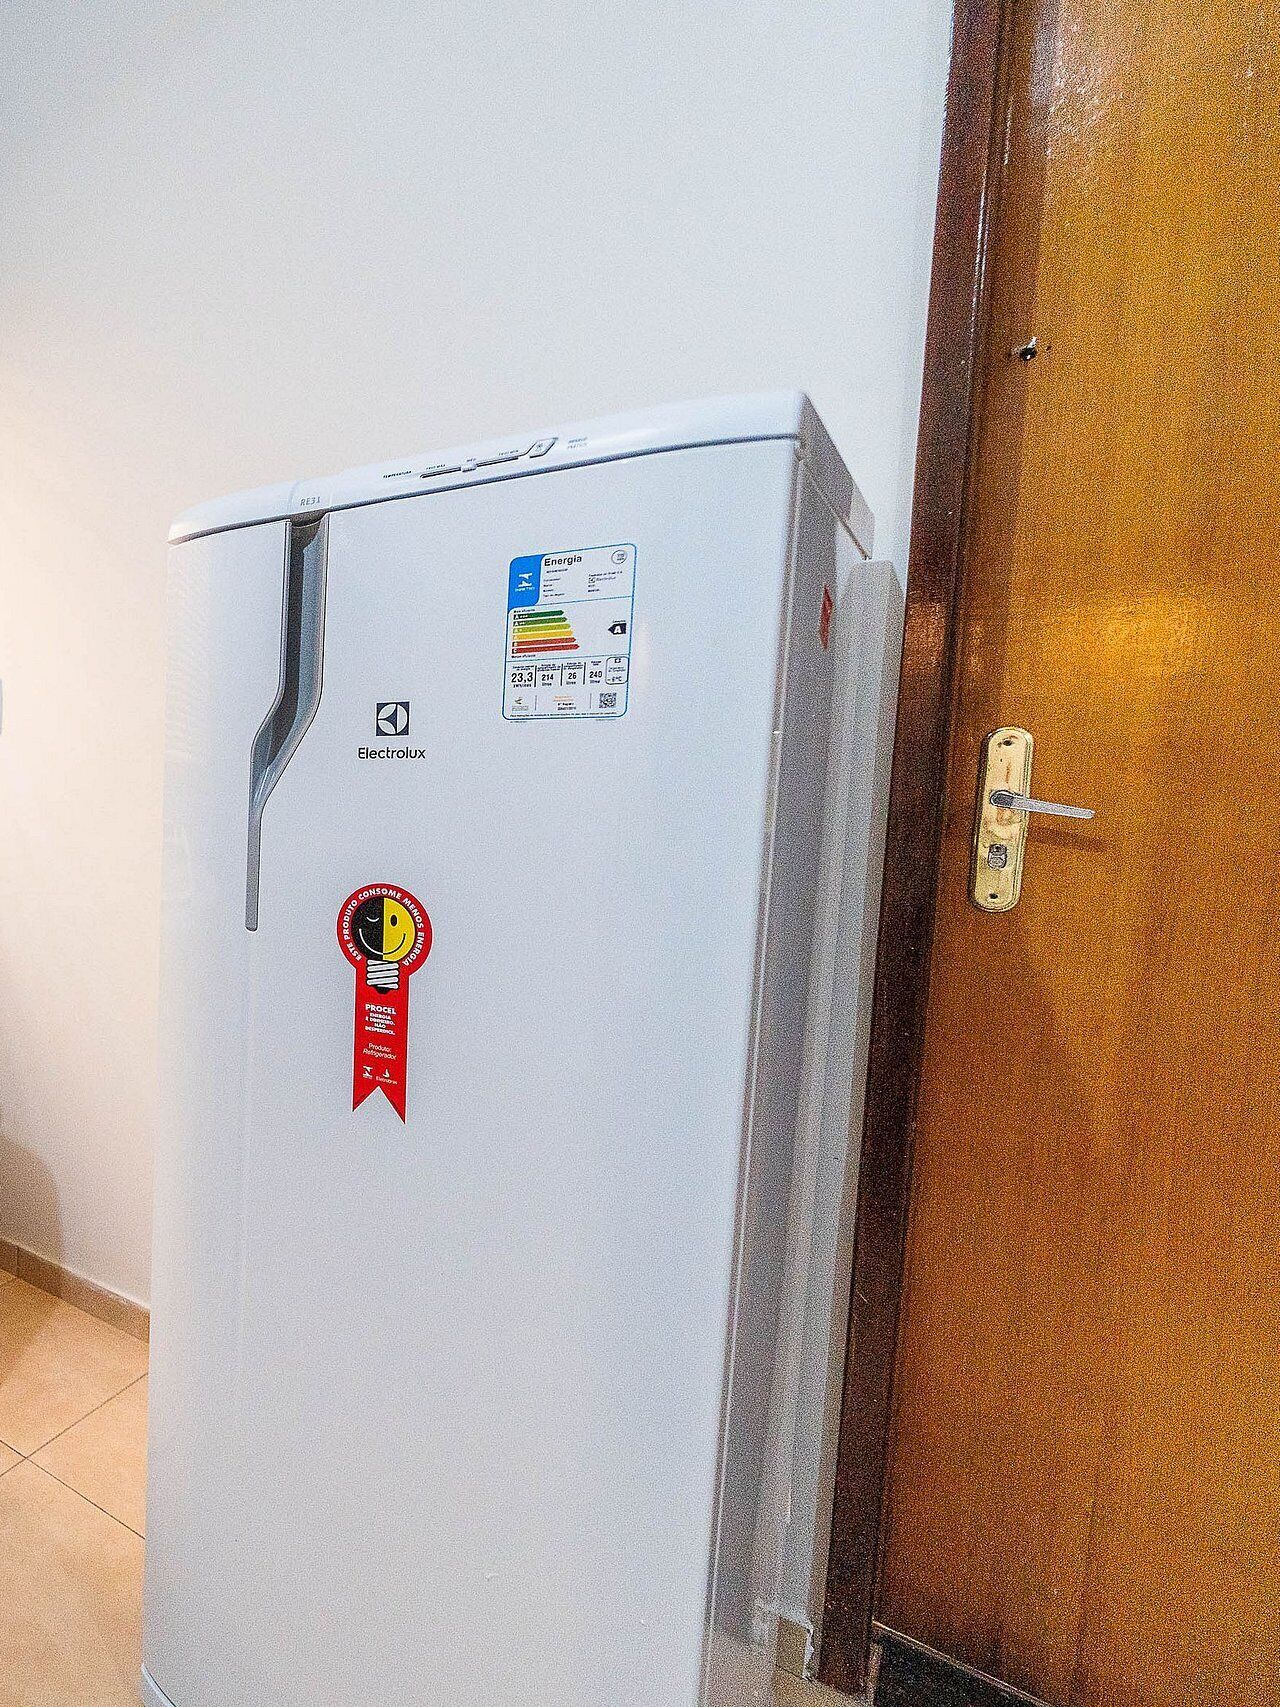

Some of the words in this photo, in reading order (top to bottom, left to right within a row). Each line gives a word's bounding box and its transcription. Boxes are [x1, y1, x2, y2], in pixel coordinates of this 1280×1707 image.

[544, 555, 583, 567] Energia
[614, 625, 622, 634] A
[511, 672, 533, 683] 23,3
[541, 673, 554, 681] 214
[567, 672, 577, 680] 26
[358, 746, 426, 759] Electrolux
[357, 887, 402, 900] CONSOME
[403, 896, 425, 929] MENOS
[343, 899, 358, 941] PRODUTO
[347, 947, 363, 961] ESTE
[402, 930, 426, 967] ENERGIA
[365, 1003, 397, 1015] PROCEL
